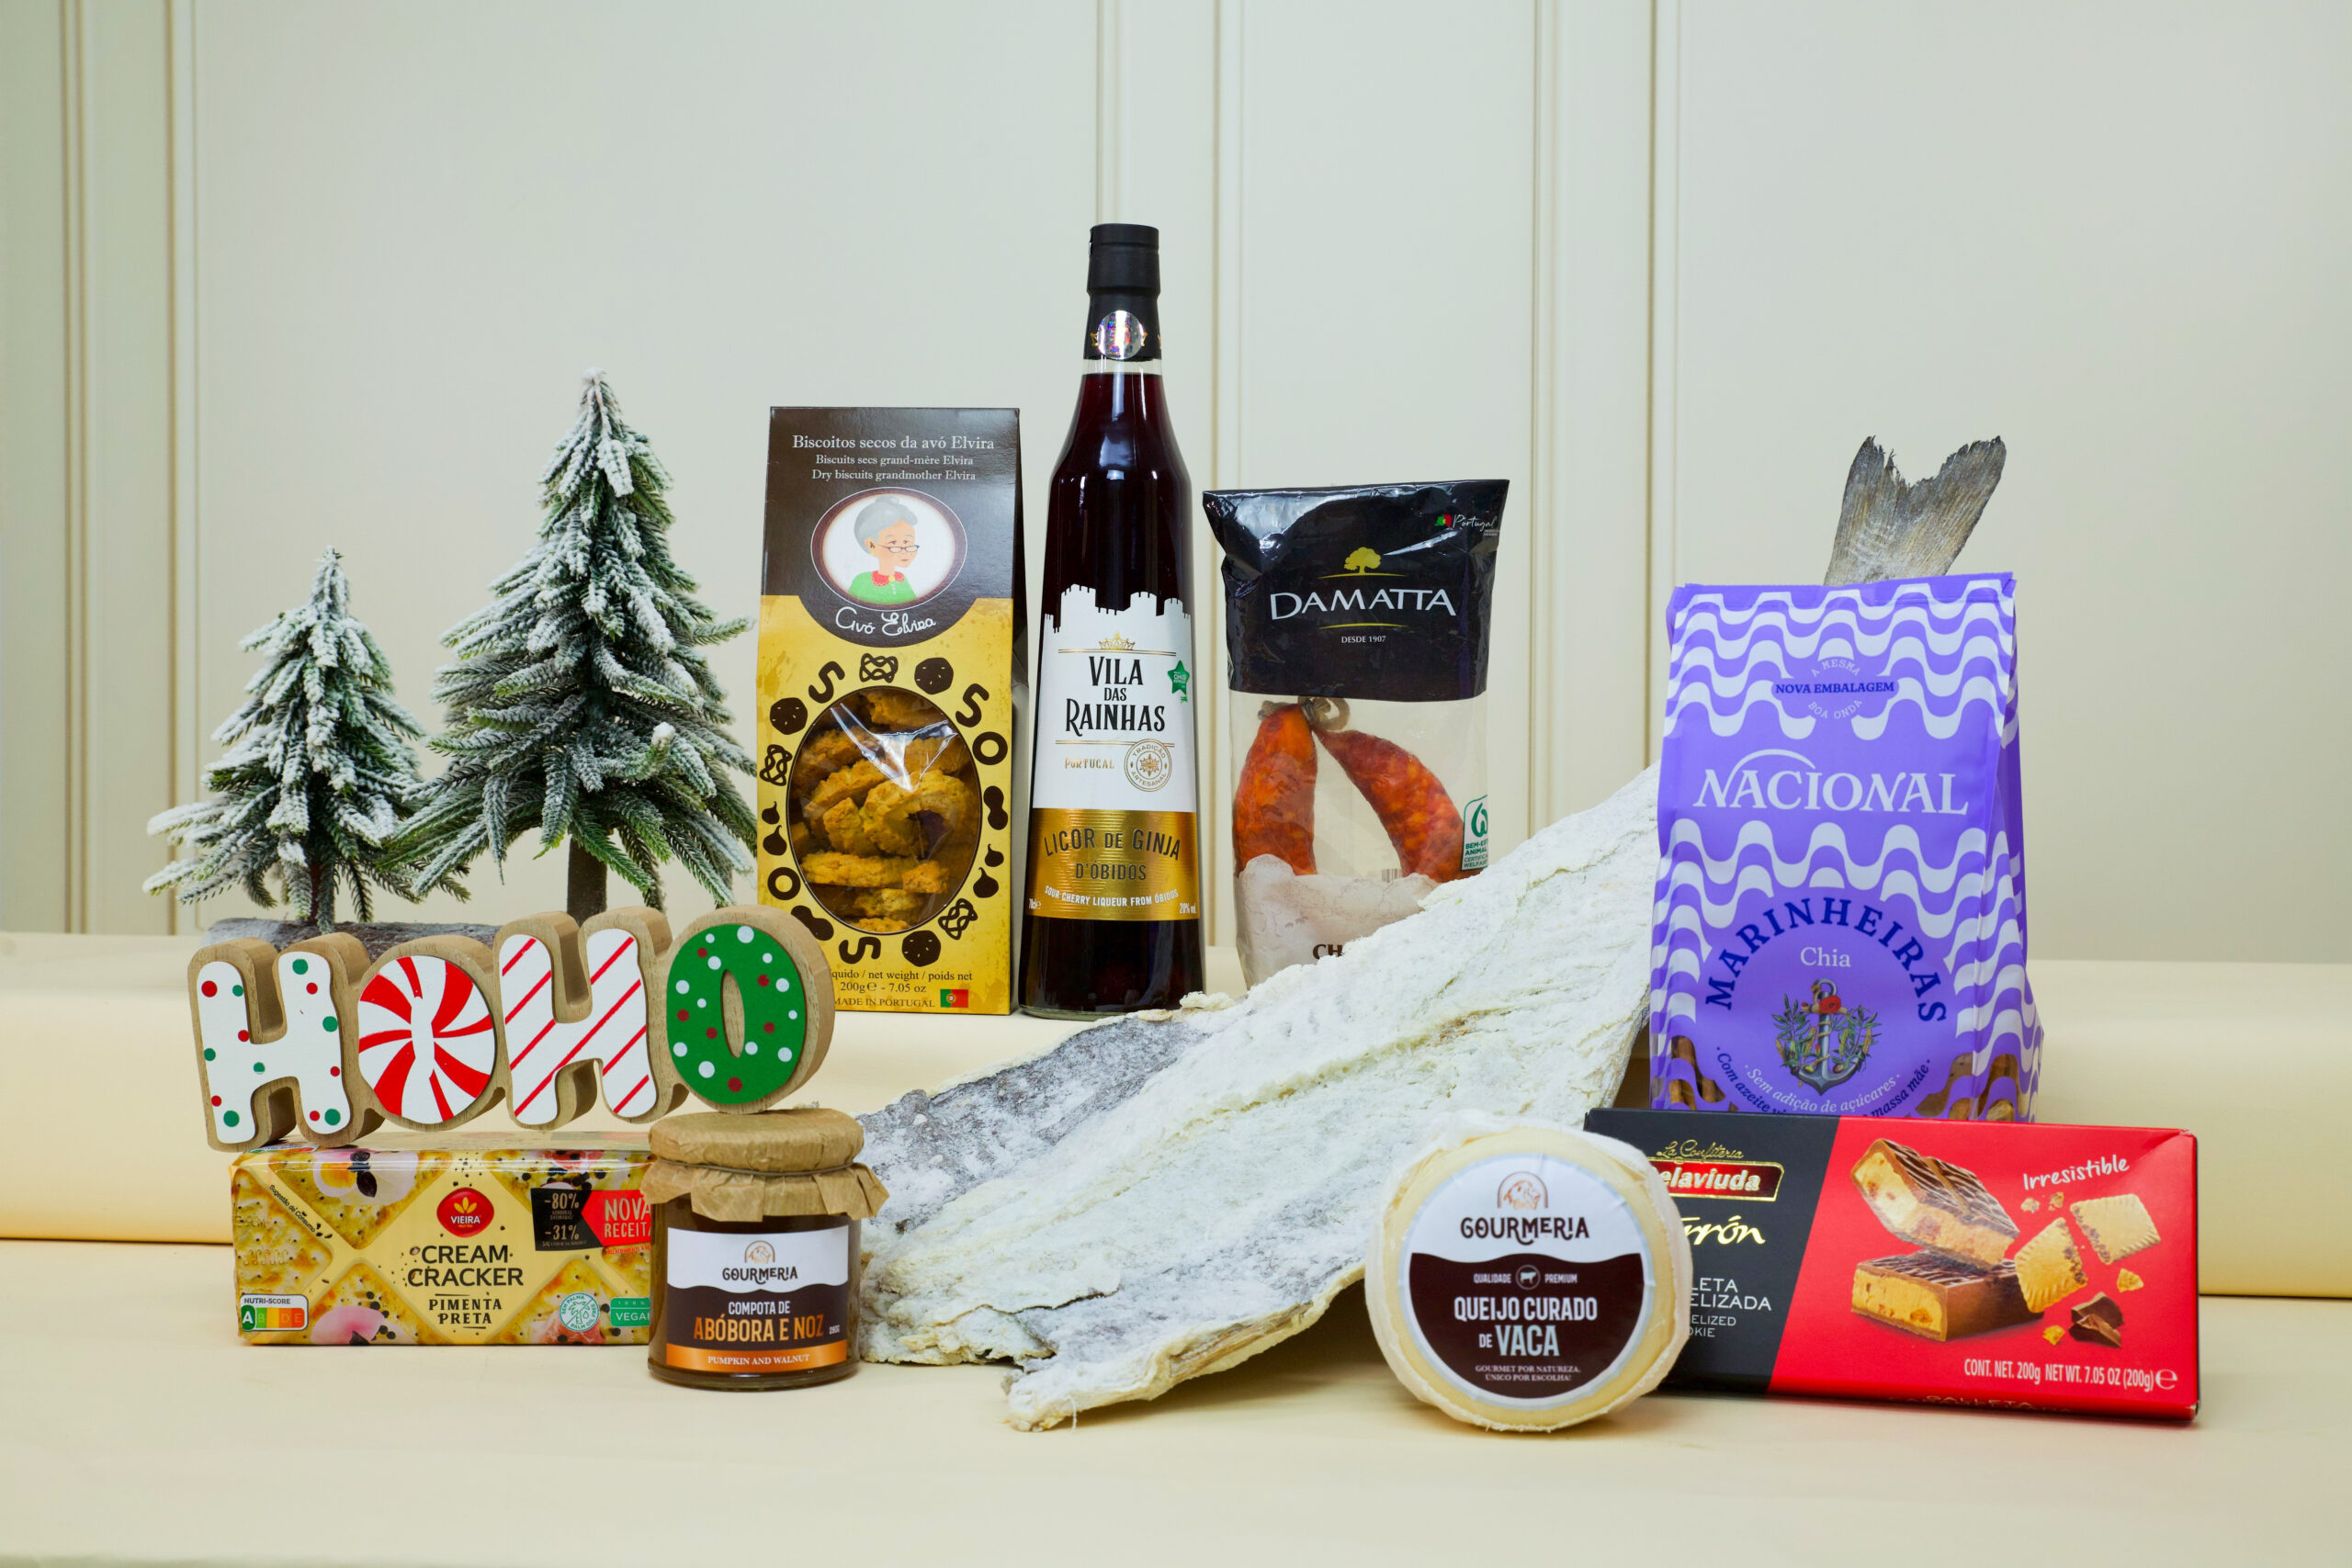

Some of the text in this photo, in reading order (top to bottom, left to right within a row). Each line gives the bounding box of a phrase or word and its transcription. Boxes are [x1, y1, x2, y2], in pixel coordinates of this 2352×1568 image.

[792, 434, 994, 449] Biscoitos secos da avó Elvira
[816, 455, 855, 465] Biscuits
[880, 455, 940, 467] grand-mère
[943, 456, 974, 466] Elvira
[812, 470, 976, 482] Dry biscuits grandmother Elvira
[1453, 513, 1497, 531] Portugal
[1271, 589, 1456, 620] DAMATTA
[882, 612, 936, 636] Elvira
[1341, 636, 1366, 644] DESDE
[1089, 656, 1143, 685] VILA
[1822, 660, 1860, 676] MESMA
[1103, 688, 1127, 701] DAS
[1776, 682, 1894, 694] NOVA EMBALAGEM
[1807, 698, 1863, 719] BOA ONDA
[1066, 698, 1165, 737] RAINHAS
[1132, 744, 1166, 759] TRADIÇÃO
[1065, 758, 1114, 769] PORTUGAL
[1131, 771, 1167, 786] ARTESANAL
[1693, 749, 1969, 815] NACIONAL
[1044, 829, 1181, 860] LICOR DE GINJA
[1045, 886, 1178, 906] SOUR CHERRY LIQUEUR FROM ÓBIDOS
[1705, 897, 1947, 1022] MARINHEIRAS
[1800, 947, 1851, 968] Chia
[831, 970, 859, 980] quido
[887, 971, 919, 981] weight
[928, 972, 954, 982] poids
[889, 983, 910, 992] 7.05
[880, 998, 935, 1007] PORTUGAL
[191, 917, 810, 1146] HOHO
[1747, 1068, 1896, 1112] Sem adição de açúcares
[1657, 1141, 1678, 1158] La
[1657, 1167, 1760, 1190] elaviuda
[2023, 1154, 2130, 1190] Irresistible
[269, 1185, 290, 1207] Sugestão
[544, 1193, 579, 1210] -80%
[605, 1198, 650, 1222] NOVA
[450, 1215, 481, 1224] VIEIRA
[545, 1225, 579, 1241] -31%
[1461, 1217, 1589, 1245] GOURMERIA
[422, 1246, 508, 1263] CREAM
[408, 1268, 524, 1286] CRACKER
[722, 1267, 797, 1285] GOURMERIA
[1474, 1273, 1577, 1283] QUALIDADE PREMIUM
[429, 1298, 502, 1310] PIMENTA
[729, 1301, 790, 1314] COMPOTA DE
[1454, 1297, 1598, 1321] QUEIJO CURADO
[243, 1311, 253, 1323] A
[438, 1313, 492, 1325] PRETA
[694, 1314, 824, 1342] ABÓBORA E NOZ
[1479, 1325, 1559, 1357] DE VACA
[707, 1354, 810, 1365] PUMPKIN AND WALNUT
[1475, 1365, 1516, 1373] GOURMET
[1964, 1359, 1992, 1377] CONT.
[1995, 1360, 2015, 1378] NET.
[2017, 1361, 2041, 1384] 200g
[2045, 1363, 2064, 1381] NET
[2065, 1365, 2082, 1382] WT.
[2085, 1366, 2105, 1384] 7.05
[2108, 1368, 2120, 1385] OZ
